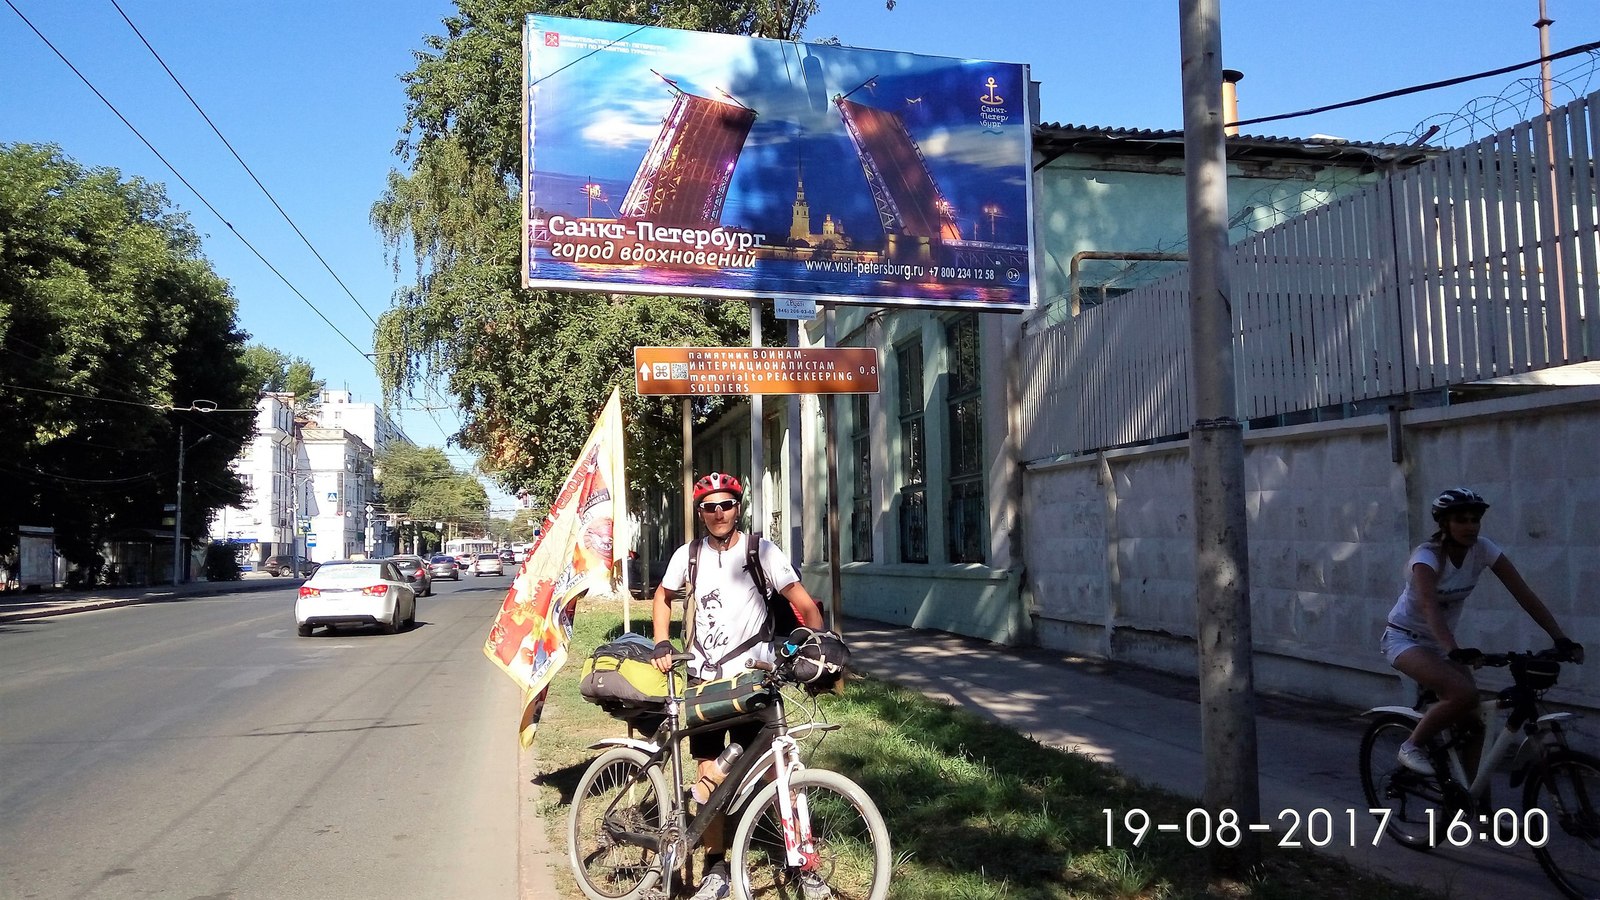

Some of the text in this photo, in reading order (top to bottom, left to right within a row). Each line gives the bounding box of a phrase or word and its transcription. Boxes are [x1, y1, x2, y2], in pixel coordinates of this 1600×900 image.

[548, 215, 767, 252] Санкт-Петербург
[551, 241, 757, 268] город вдохновений
[805, 259, 924, 280] www.visit-petersburg.ru
[929, 266, 995, 280] +7 800 234 12 58
[689, 350, 808, 360] памятник ВОИНАМ-
[689, 361, 835, 372] ИНТЕРНАЦИОНАЛИСТАМ
[859, 365, 876, 376] 0,8
[690, 372, 853, 382] memorial to PEACEKEEPING
[690, 383, 750, 393] SOLDIERS
[703, 630, 729, 651] Che
